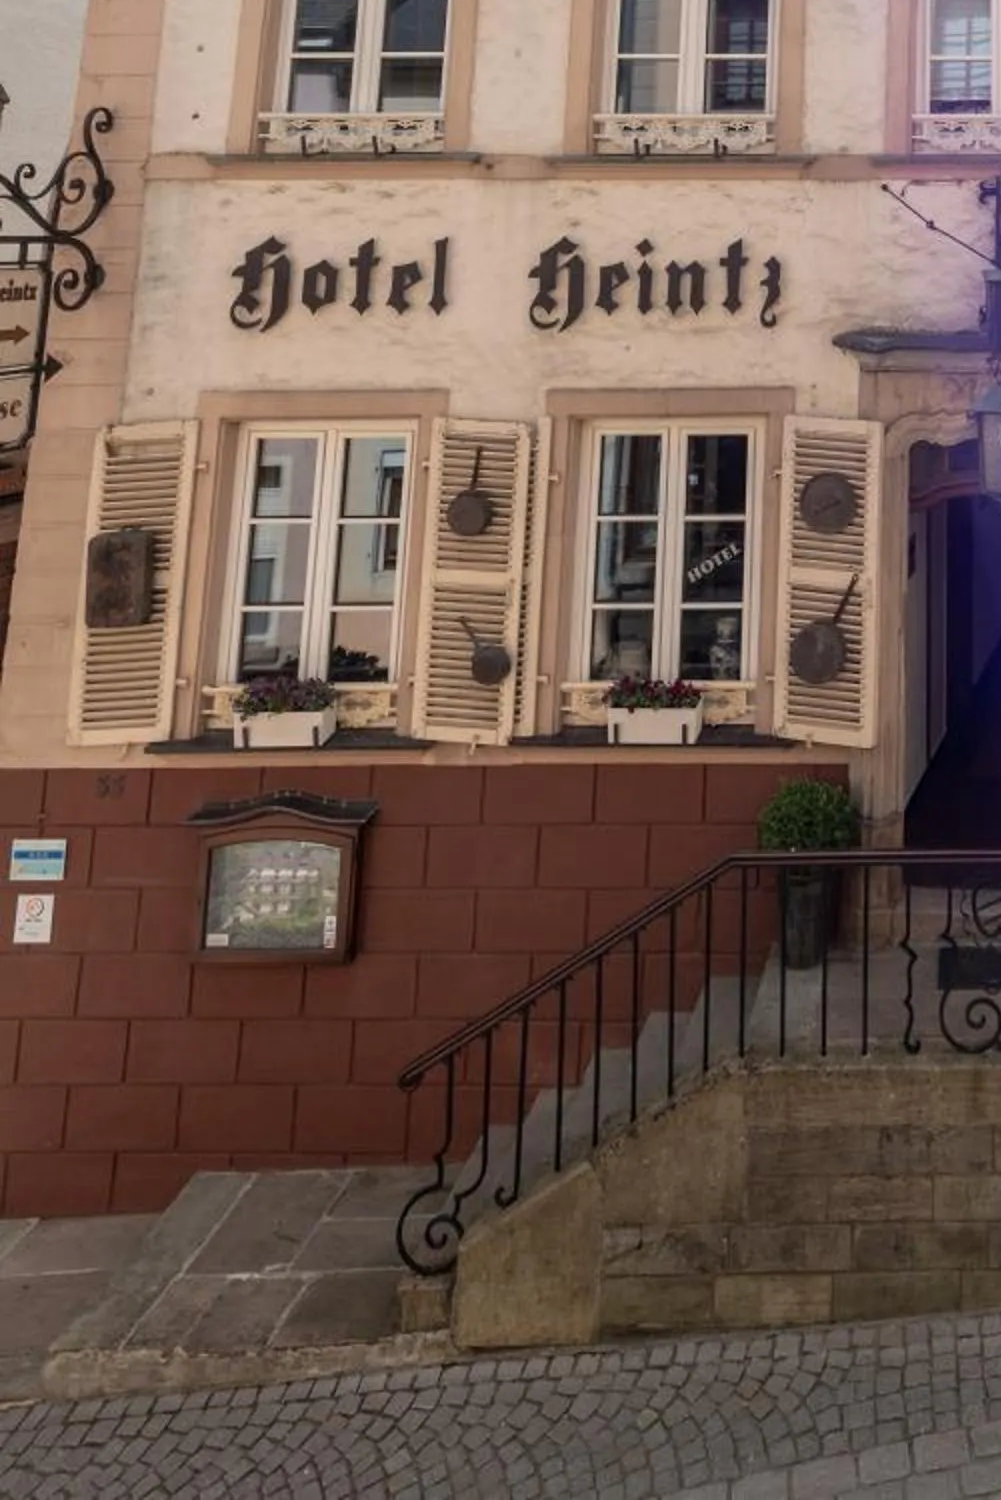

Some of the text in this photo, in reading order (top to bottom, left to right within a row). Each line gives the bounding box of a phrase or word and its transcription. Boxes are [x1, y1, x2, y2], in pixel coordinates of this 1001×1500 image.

[229, 235, 784, 334] Hotel Heintz
[687, 543, 742, 583] HOTEL
